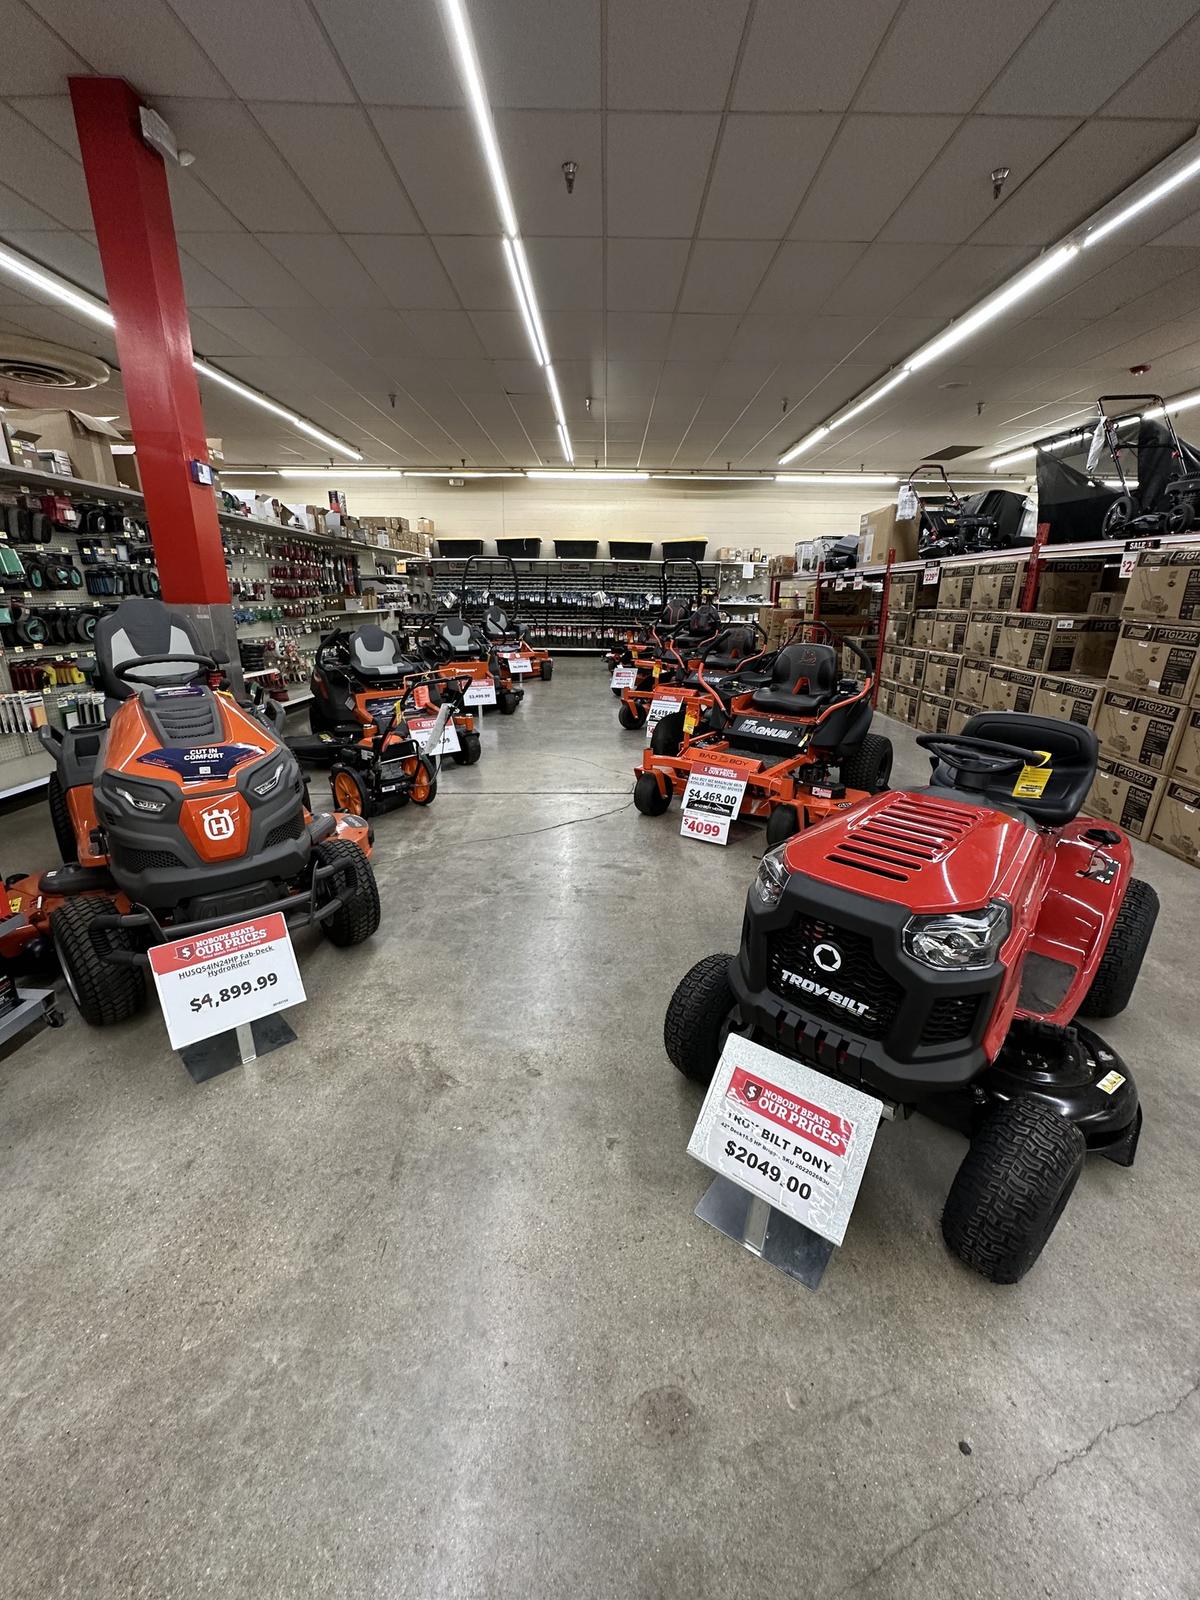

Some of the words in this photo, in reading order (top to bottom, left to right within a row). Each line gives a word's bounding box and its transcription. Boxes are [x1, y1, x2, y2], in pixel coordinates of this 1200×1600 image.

[1129, 541, 1147, 550] SALE
[1157, 629, 1199, 640] PTG12212
[1065, 683, 1094, 696] PTG12212
[1137, 699, 1176, 716] PTG12212
[737, 724, 792, 739] MAGNUM
[183, 752, 224, 761] COMFORT
[699, 752, 718, 760] BAD
[729, 758, 749, 767] BOY
[1118, 765, 1153, 785] PTG12212
[683, 818, 721, 837] $4099
[195, 932, 229, 947] NOBODY
[230, 926, 255, 938] BEATS
[195, 943, 224, 957] OUR
[224, 929, 267, 949] PRICES
[240, 945, 274, 961] Fab-Deck
[207, 960, 251, 978] HydroRider
[189, 972, 278, 1013] $4,899.99
[781, 969, 870, 1017] TROY-BILT
[763, 1089, 801, 1111] NOBODY
[800, 1107, 831, 1128] BEATS
[758, 1097, 788, 1121] OUR
[789, 1113, 841, 1147] PRICES
[760, 1128, 791, 1150] BILT
[793, 1145, 832, 1174] PONY
[724, 1139, 812, 1200] $2049.00
